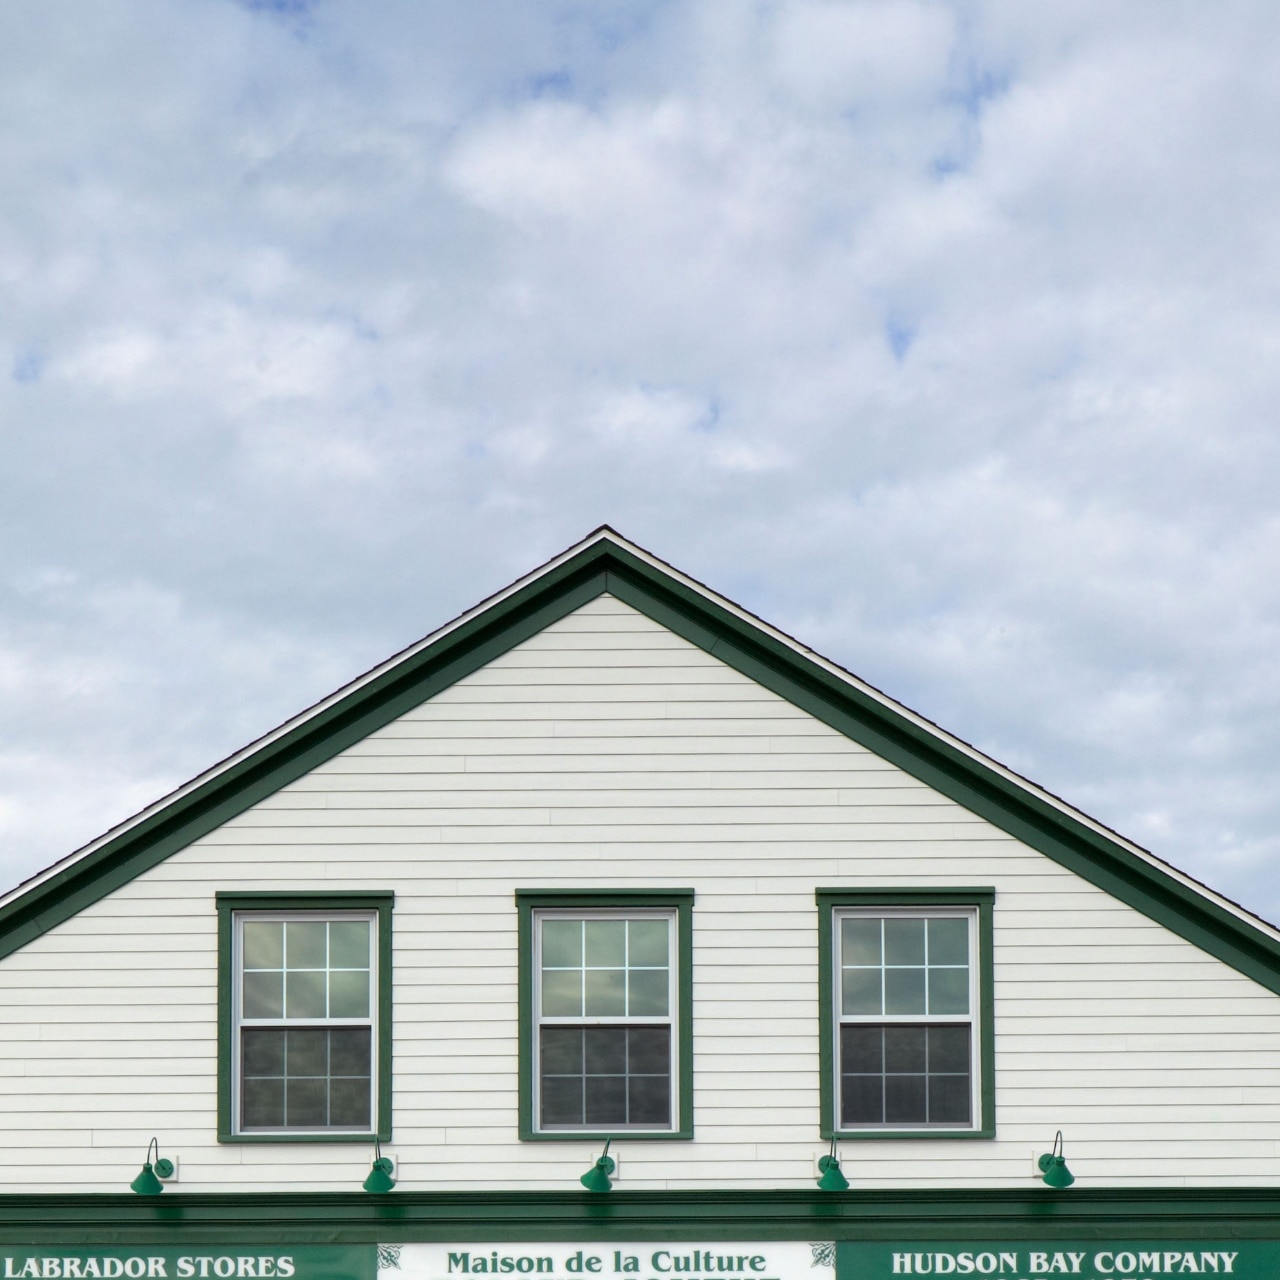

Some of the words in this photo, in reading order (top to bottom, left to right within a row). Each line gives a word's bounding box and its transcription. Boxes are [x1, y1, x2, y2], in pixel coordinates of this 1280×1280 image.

[4, 1256, 167, 1279] LABRADOR
[176, 1256, 296, 1278] STORES
[447, 1251, 554, 1274] Maison
[565, 1250, 602, 1273] de
[614, 1250, 640, 1273] la
[651, 1250, 767, 1273] Culture
[892, 1251, 1018, 1274] HUDSON
[1029, 1252, 1086, 1273] BAY
[1094, 1251, 1239, 1273] COMPANY
